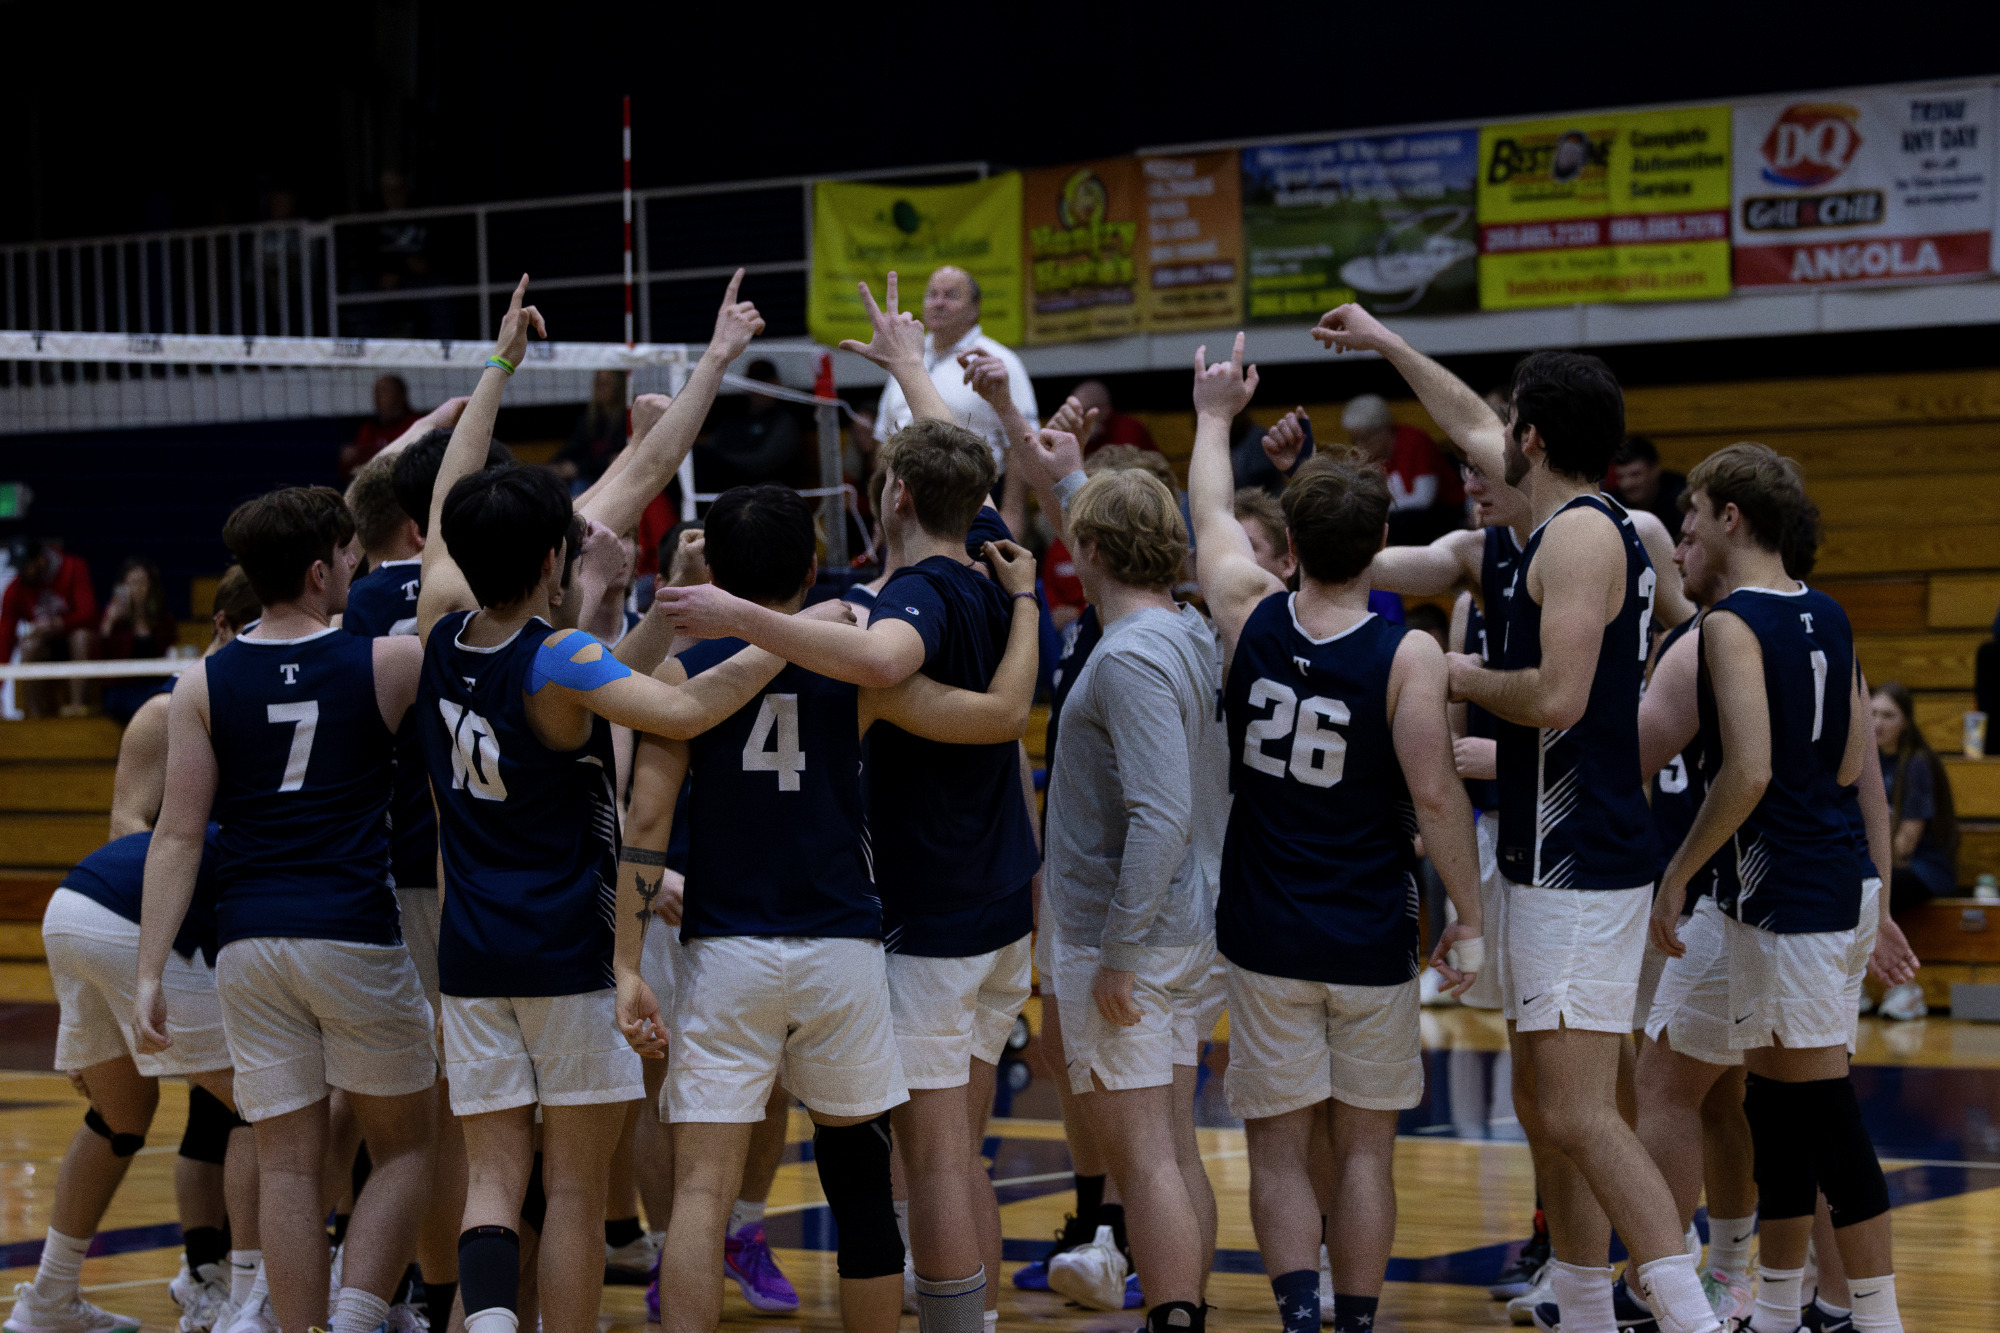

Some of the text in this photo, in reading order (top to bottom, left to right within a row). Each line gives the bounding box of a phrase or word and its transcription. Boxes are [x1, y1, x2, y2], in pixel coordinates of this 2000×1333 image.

[1772, 121, 1853, 170] DQ
[1788, 239, 1943, 282] ANGOLA
[400, 578, 420, 601] T
[1799, 612, 1815, 634] T
[279, 662, 300, 686] T
[1292, 654, 1312, 677] T
[1809, 649, 1829, 743] 1
[266, 699, 320, 793] 7
[438, 697, 508, 802] 10
[742, 692, 806, 792] 4
[1242, 676, 1352, 789] 26
